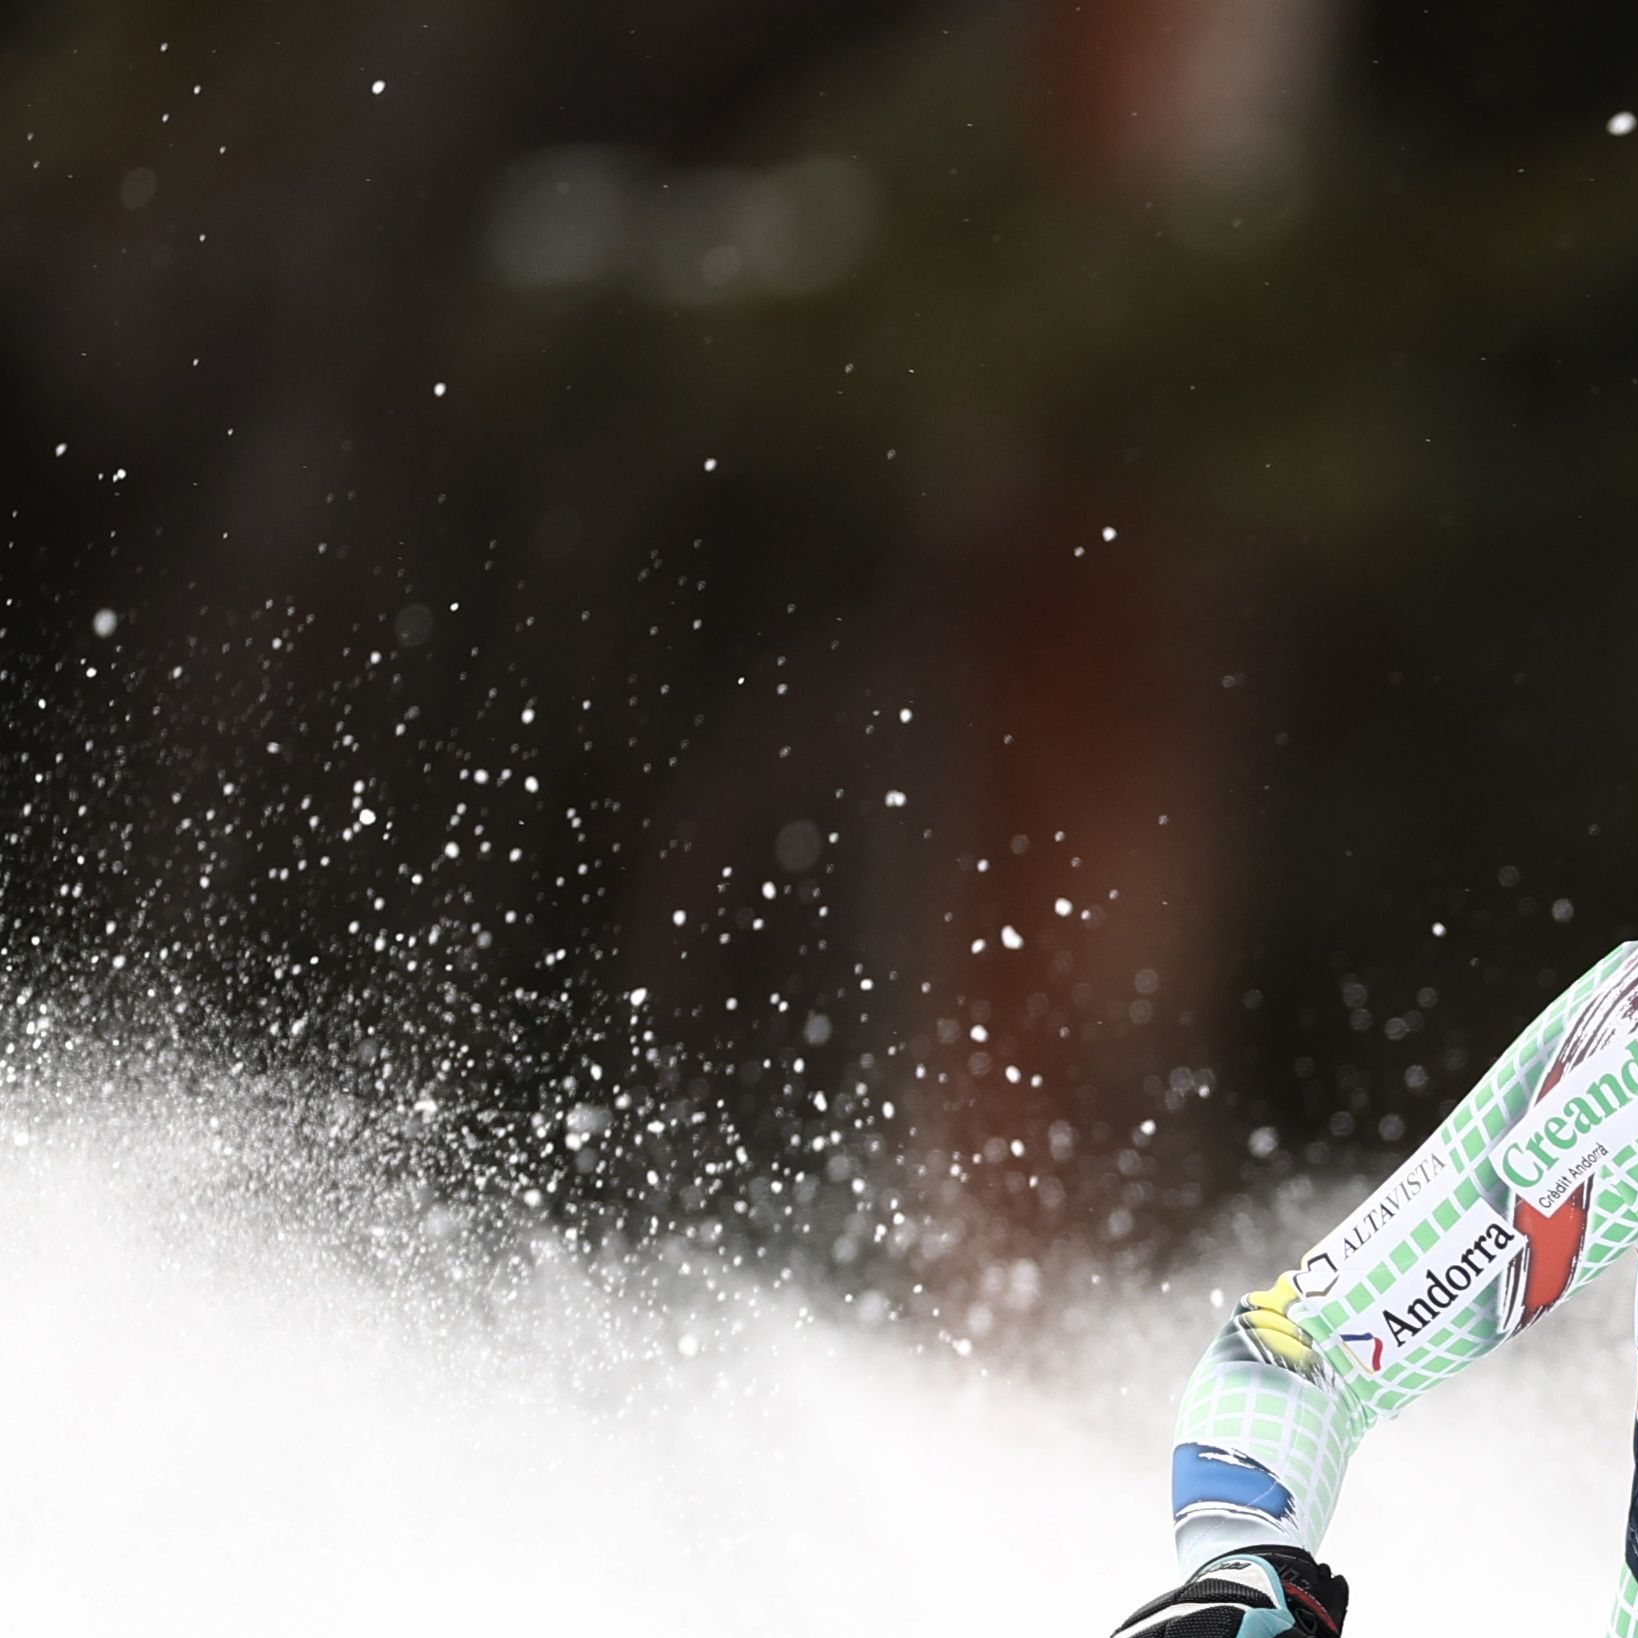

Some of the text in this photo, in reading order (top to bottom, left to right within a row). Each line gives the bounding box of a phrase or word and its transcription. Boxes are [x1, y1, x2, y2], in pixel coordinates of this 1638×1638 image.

[1341, 1152, 1448, 1262] ALTAVISTA
[1538, 1175, 1573, 1209] Crèdit
[1380, 1219, 1515, 1347] Andorra
